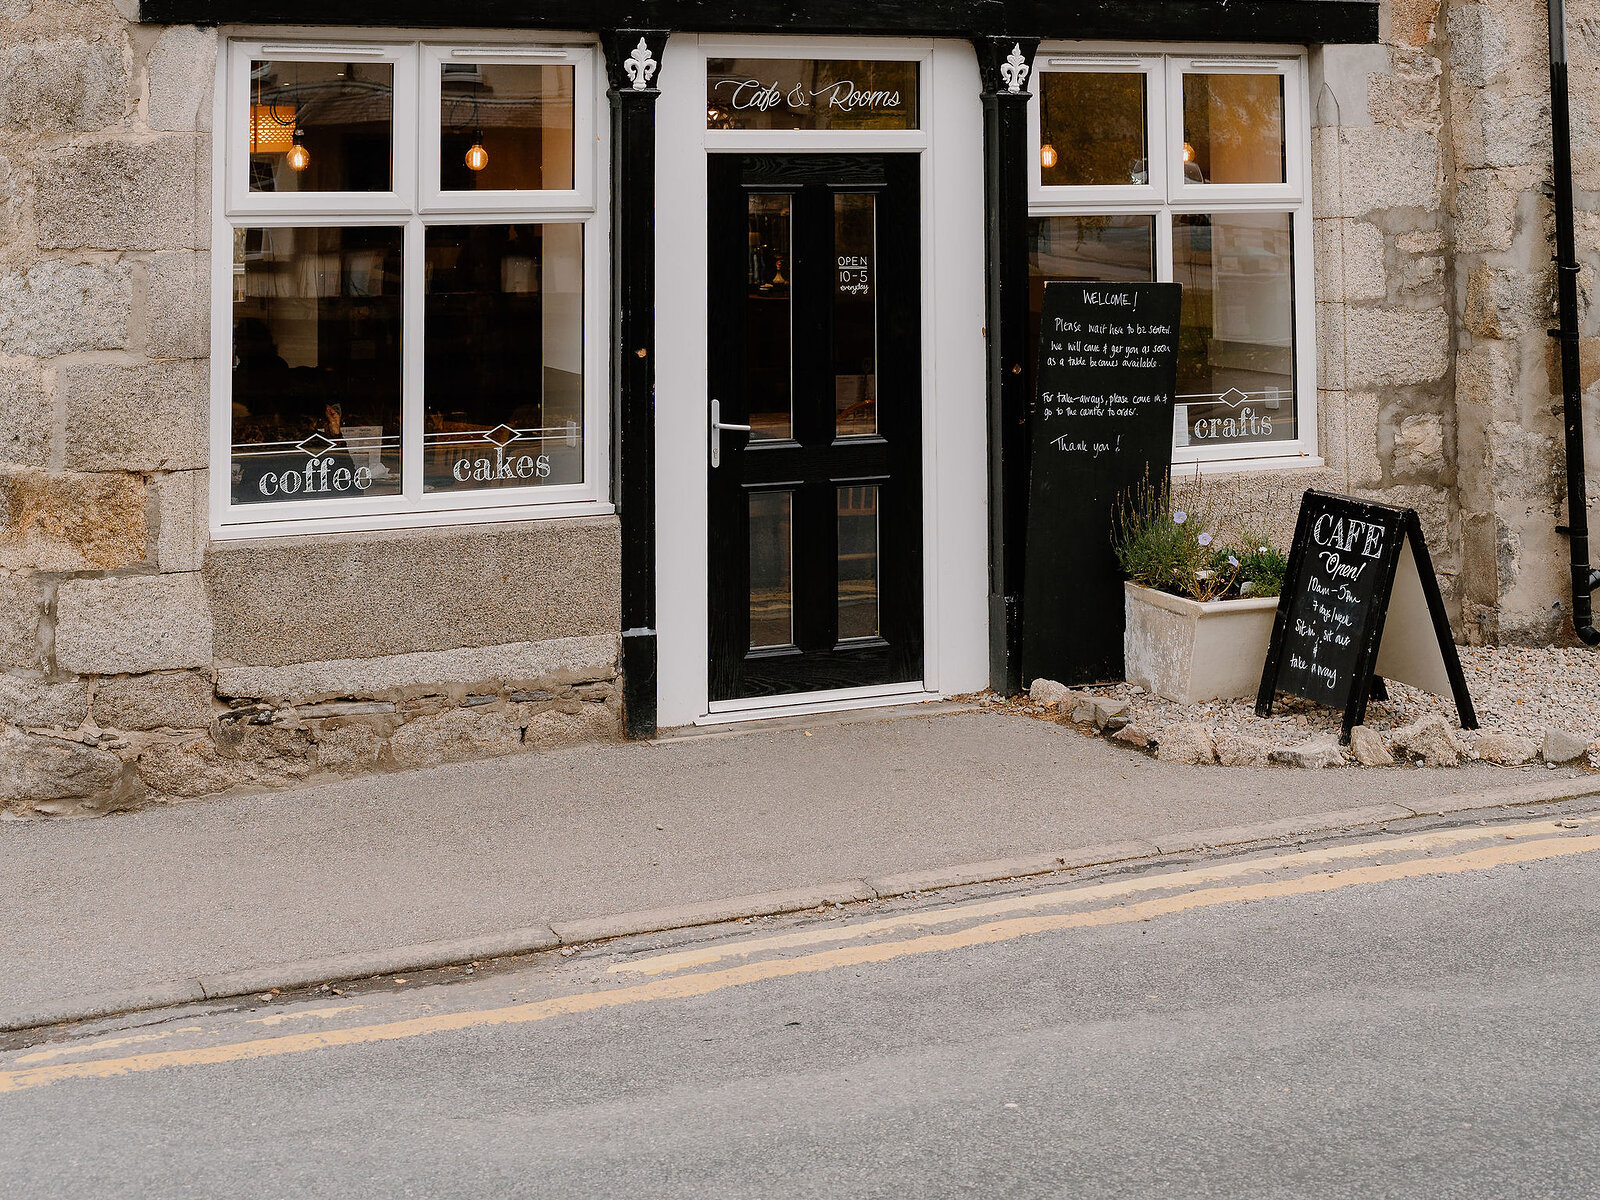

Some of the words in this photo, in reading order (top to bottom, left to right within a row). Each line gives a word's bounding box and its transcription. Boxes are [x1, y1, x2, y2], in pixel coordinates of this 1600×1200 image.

[714, 79, 782, 112] Cafe
[787, 82, 809, 108] &
[809, 80, 901, 112] Rooms
[837, 256, 868, 266] OPEN
[840, 283, 869, 295] everyday
[1054, 317, 1082, 332] Please
[1088, 324, 1108, 334] wait
[1109, 323, 1124, 335] here
[1126, 323, 1135, 335] to
[1136, 323, 1147, 335] be
[1067, 341, 1081, 353] will
[1083, 343, 1100, 353] come
[1109, 345, 1123, 359] get
[1125, 346, 1139, 359] you
[1141, 345, 1150, 354] as
[1152, 344, 1171, 353] soon
[1047, 357, 1057, 366] as
[1059, 358, 1065, 367] a
[1067, 356, 1087, 366] table
[1089, 356, 1119, 367] becomes
[1042, 391, 1054, 403] For
[1108, 392, 1129, 406] please
[1132, 395, 1151, 404] come
[1043, 408, 1053, 421] go
[1055, 407, 1064, 416] to
[1065, 406, 1078, 417] the
[1107, 407, 1116, 417] to
[1194, 407, 1273, 440] crafts
[1049, 433, 1088, 452] Thank
[1093, 442, 1110, 459] you
[452, 447, 551, 482] cakes
[258, 457, 373, 496] coffee
[1313, 513, 1385, 559] CAFE
[1290, 653, 1308, 670] take
